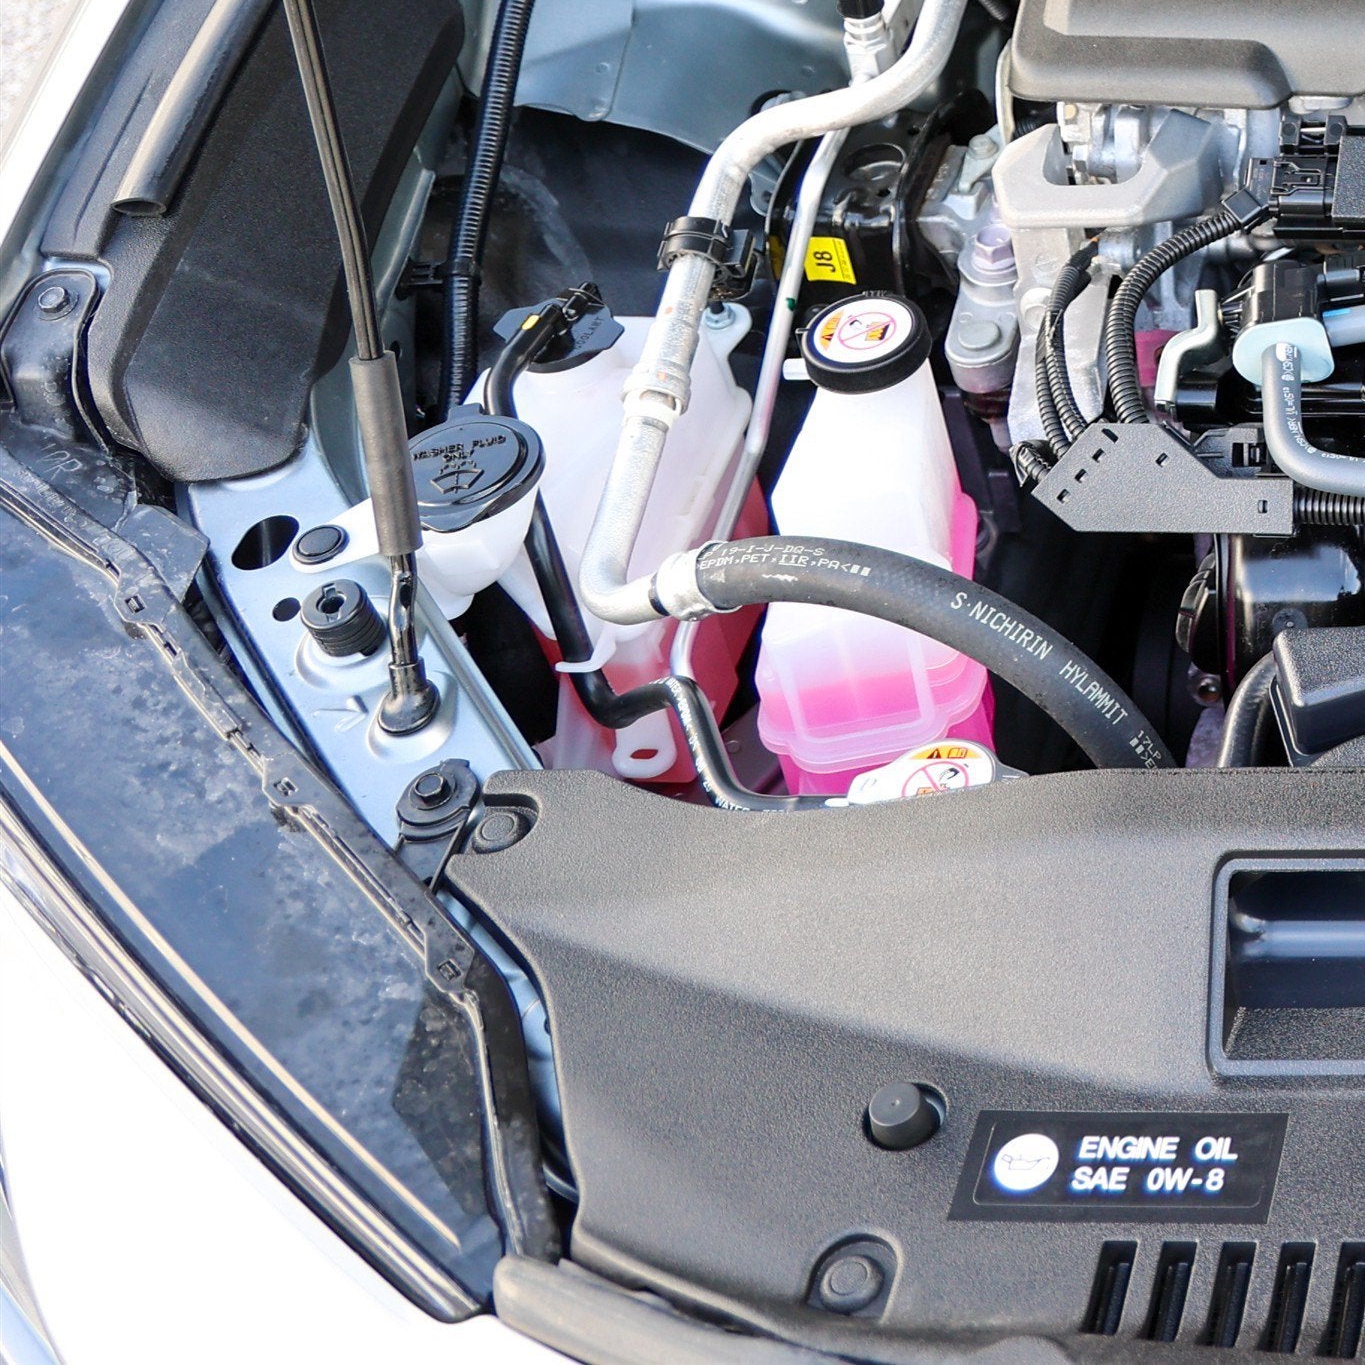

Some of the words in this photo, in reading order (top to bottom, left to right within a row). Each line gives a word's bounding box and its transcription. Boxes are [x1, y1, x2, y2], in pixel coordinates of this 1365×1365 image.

[813, 250, 836, 273] J8
[471, 435, 507, 449] FLUID
[443, 449, 476, 463] ONLY
[697, 553, 852, 572] EPDM,PET,IIR,PA<
[1059, 660, 1129, 725] HYLAMMIT
[1078, 1136, 1180, 1161] ENGINE
[1195, 1136, 1239, 1161] OIL
[1070, 1167, 1132, 1191] SAE
[1146, 1167, 1225, 1191] 0W-8
